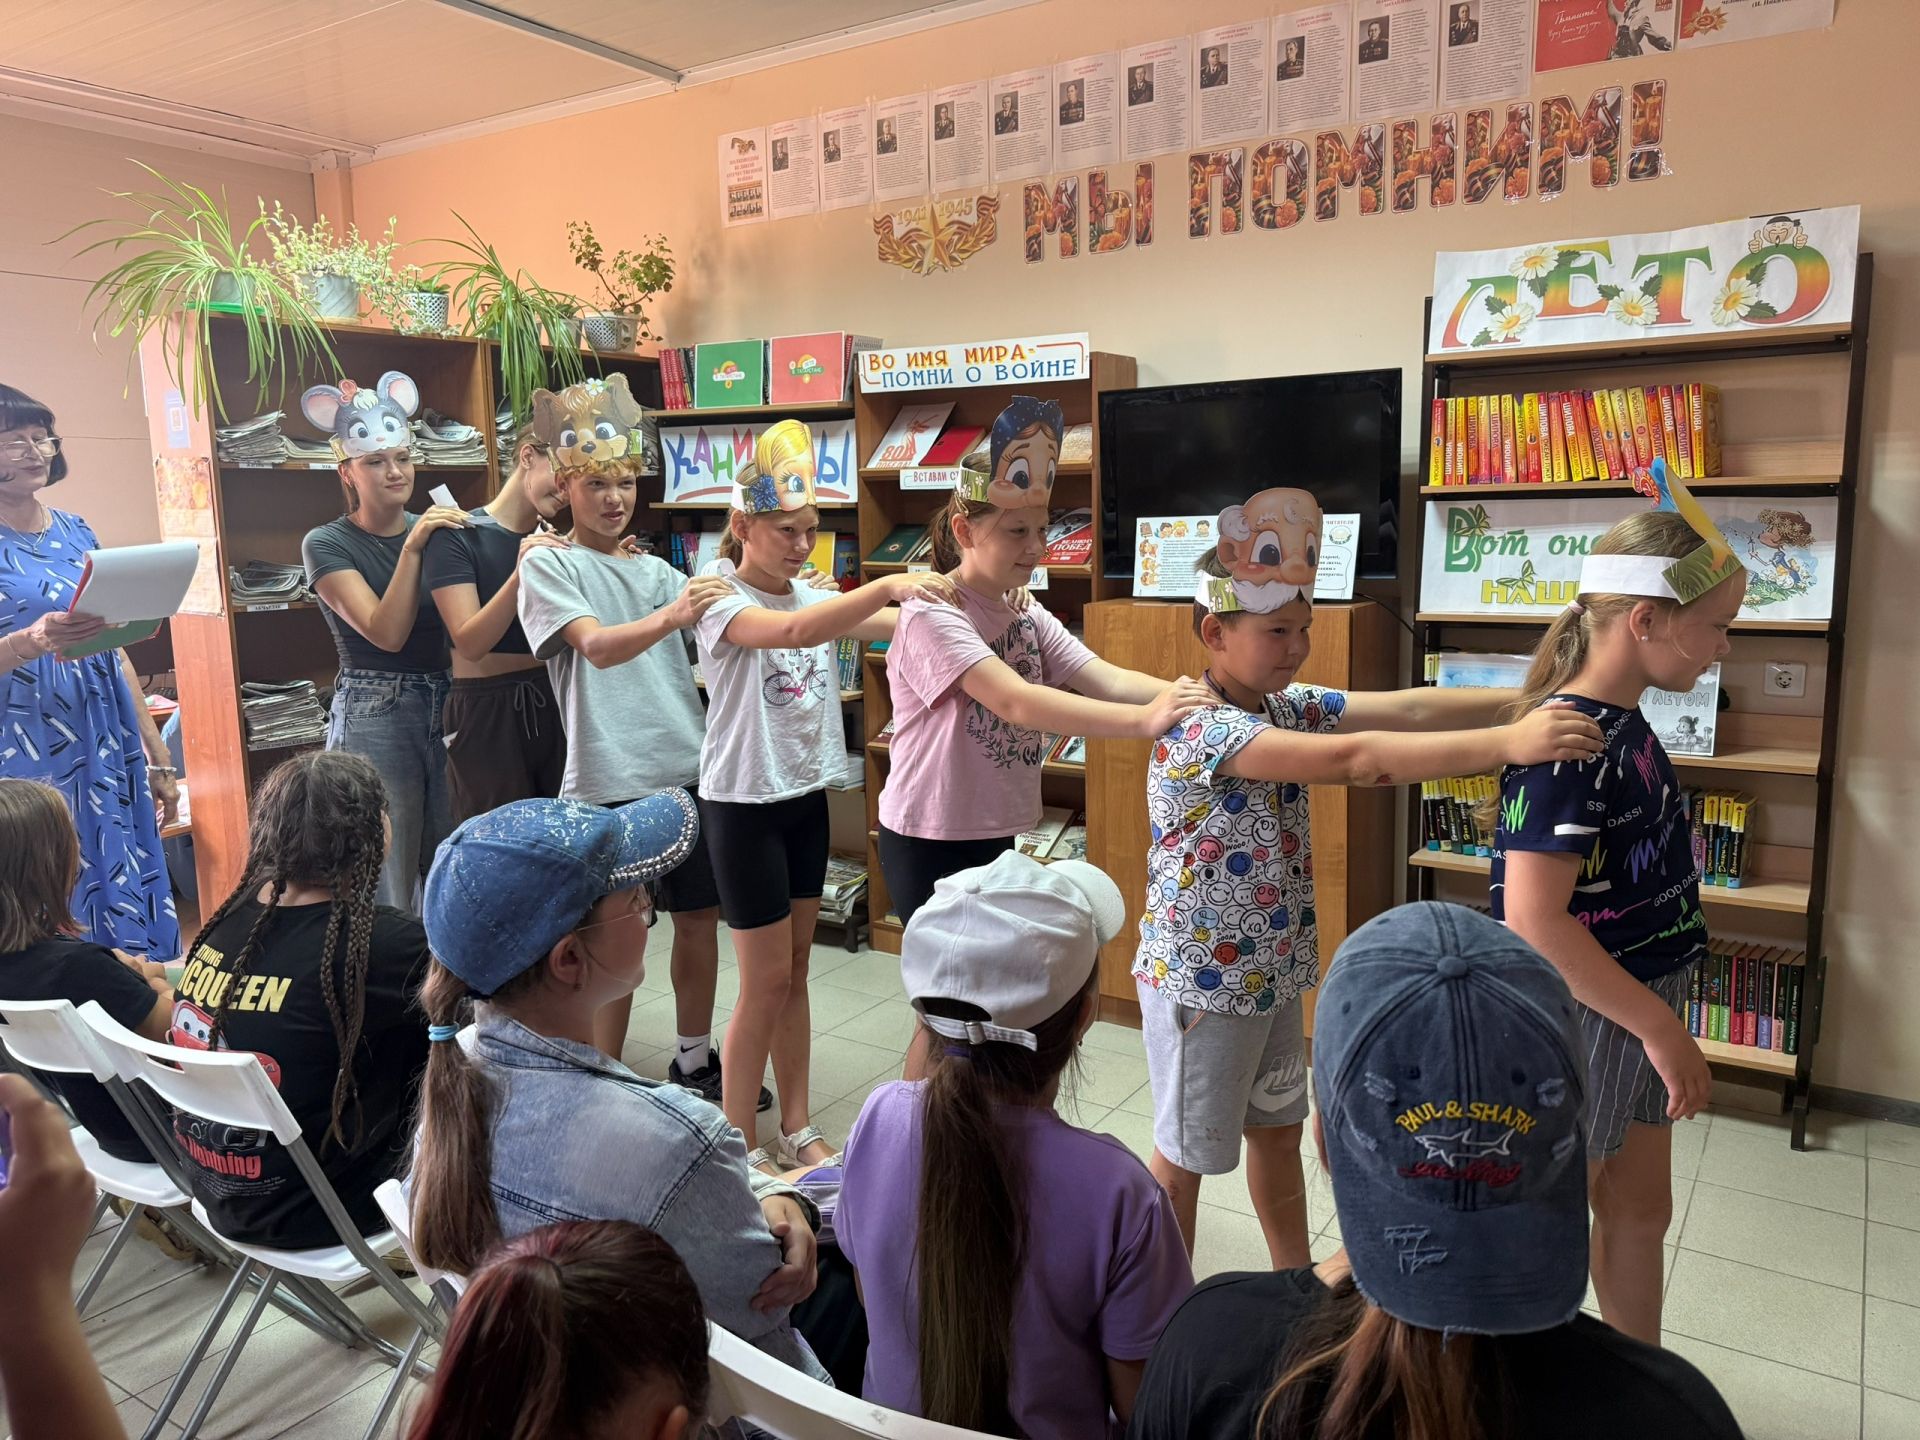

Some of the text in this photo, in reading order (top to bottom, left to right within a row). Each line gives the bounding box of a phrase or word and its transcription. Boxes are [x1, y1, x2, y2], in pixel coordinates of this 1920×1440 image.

[1023, 80, 1666, 264] МЫ ПОМНИМ!
[897, 198, 974, 226] 1941 1945
[1441, 239, 1831, 348] ЛЕТО
[869, 354, 895, 371] ВО
[907, 350, 948, 368] ИМЯ
[881, 359, 1077, 388] ПОМНИ О ВОЙНЕ
[1491, 413, 1500, 448] ШИЛОВА
[1538, 403, 1549, 437] ШИЛОВА
[1562, 402, 1576, 436] ШИЛОВА
[1662, 396, 1674, 432] ШИЛОВА
[1693, 394, 1702, 432] ШИЛОВА
[882, 445, 905, 460] 80
[1504, 438, 1512, 473] ШИЛОВА
[1592, 427, 1604, 462] ШИЛОВА
[1679, 421, 1689, 459] ШИЛОВА
[1456, 441, 1464, 475] ШИЛОВА
[1444, 507, 1529, 572] Вот
[1607, 806, 1643, 828] DASSI
[1653, 884, 1683, 907] GOOD
[1395, 1100, 1537, 1135] PAUL & SHARK
